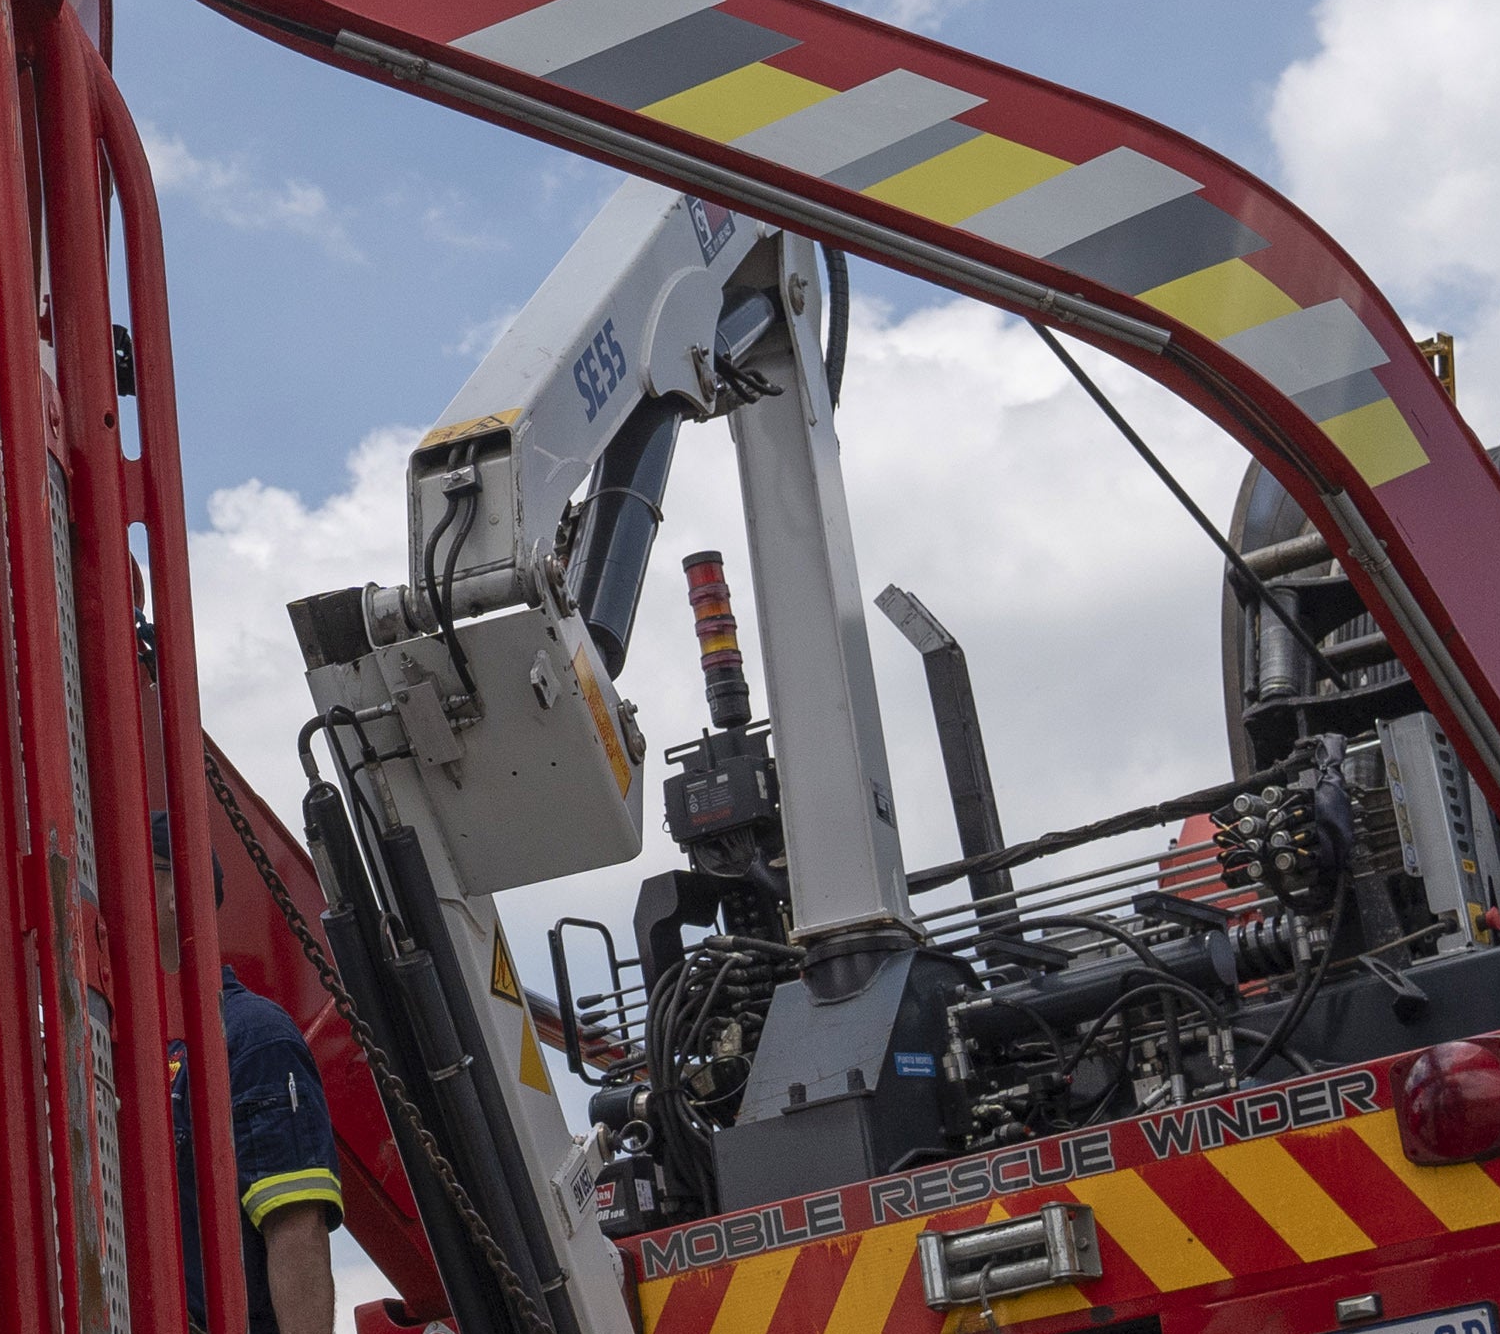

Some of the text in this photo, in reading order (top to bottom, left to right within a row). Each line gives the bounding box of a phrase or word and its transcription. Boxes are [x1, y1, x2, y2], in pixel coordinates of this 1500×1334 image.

[641, 1069, 1380, 1279] MOBILE RESCUE WINDER
